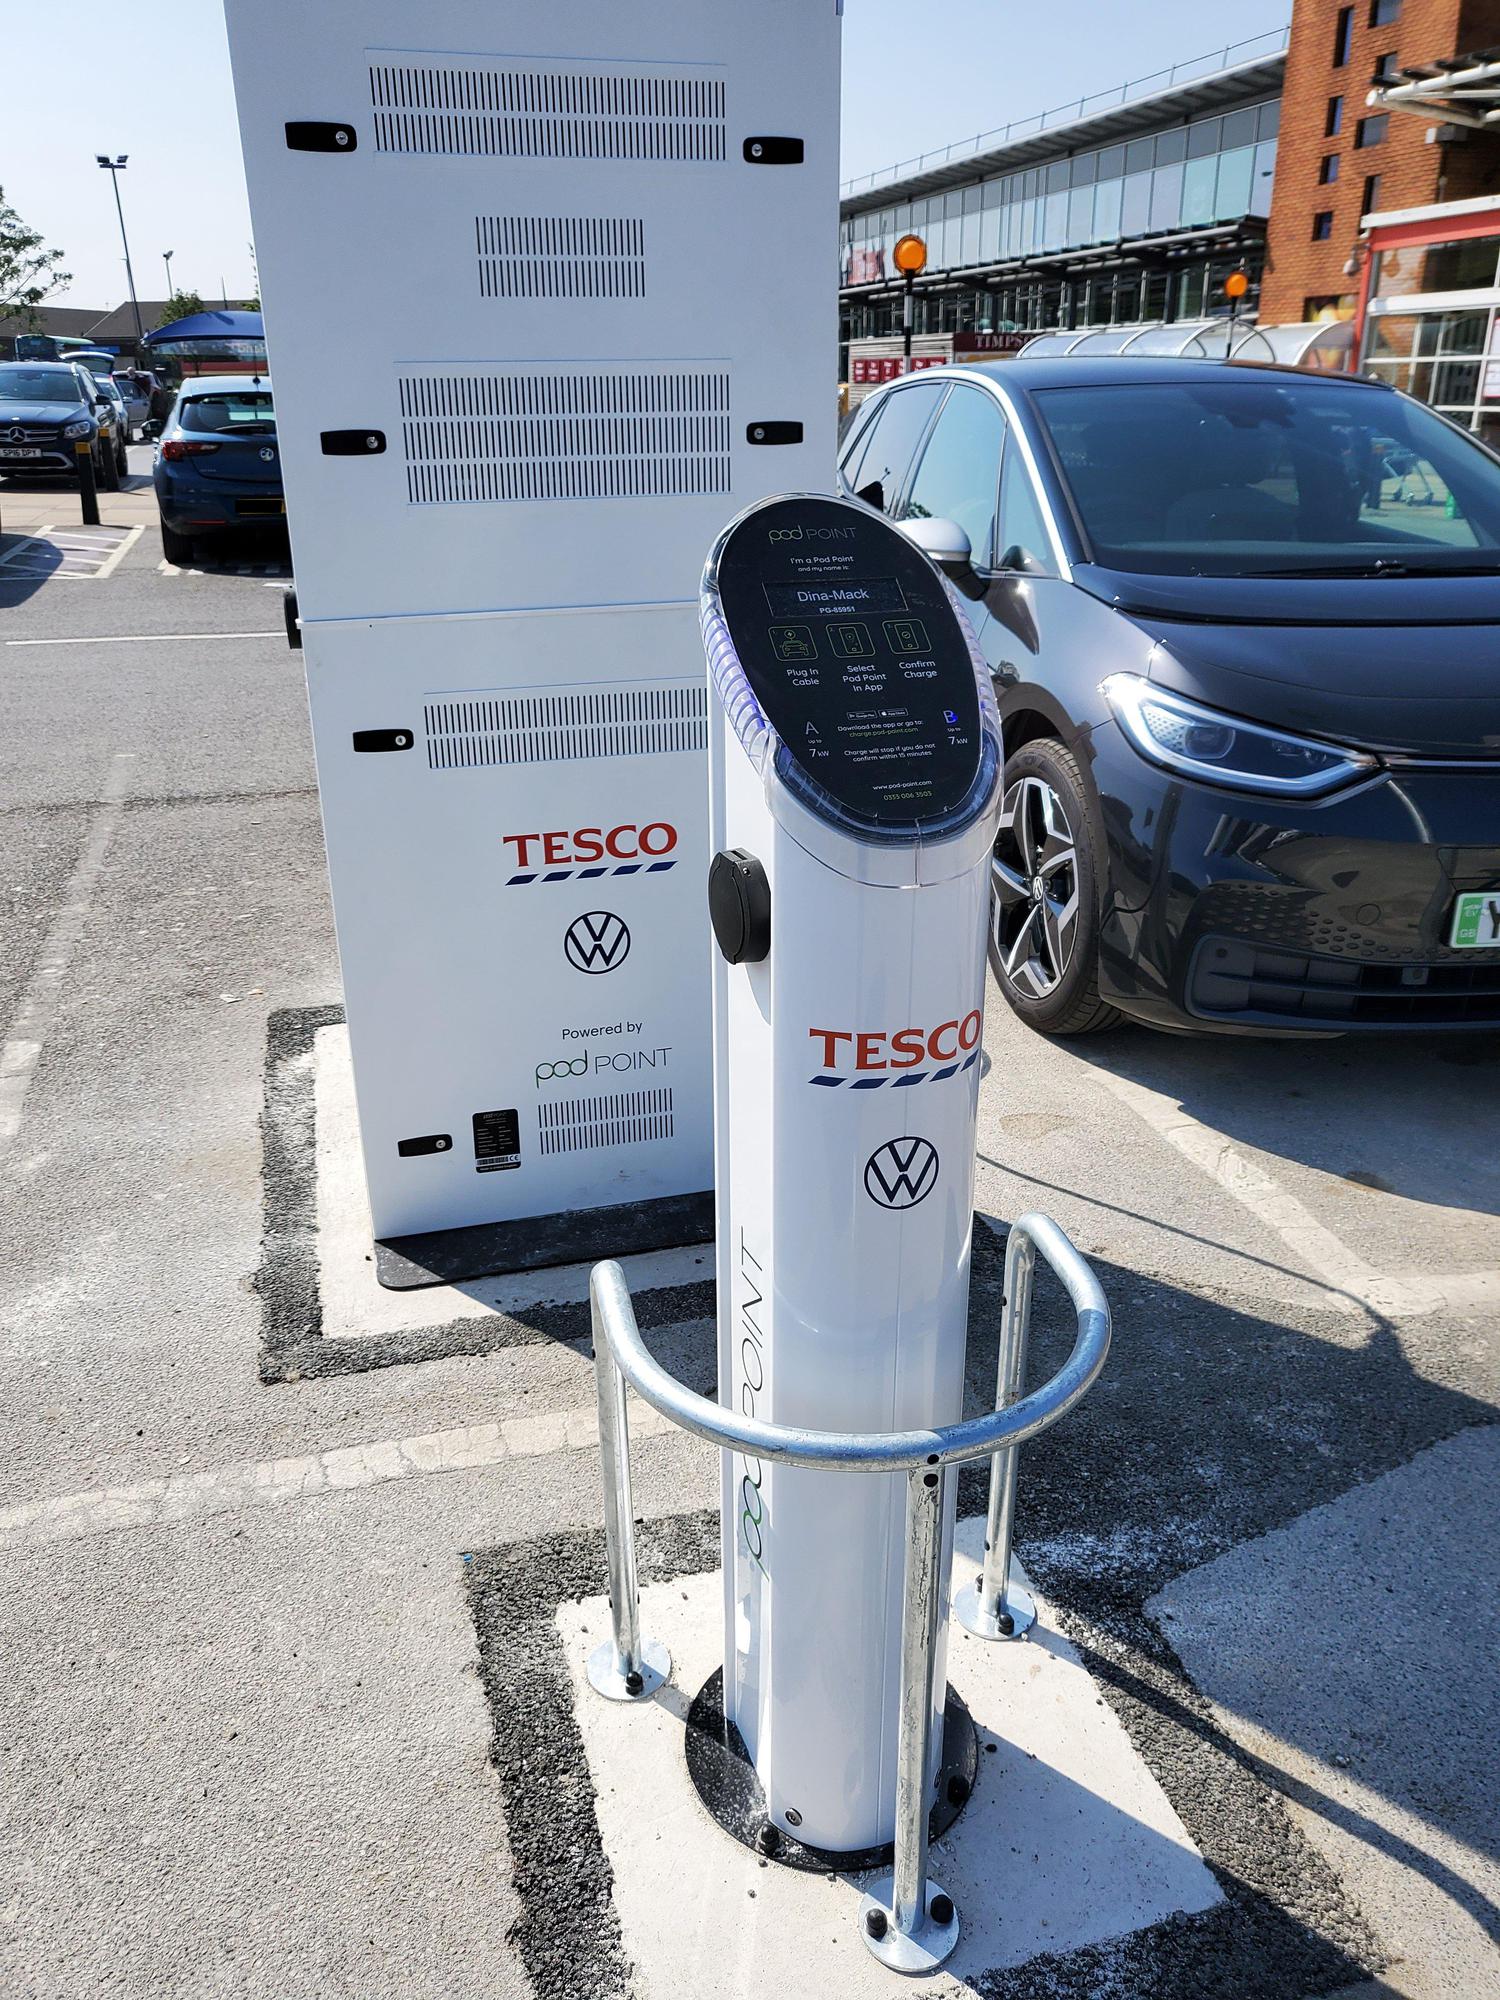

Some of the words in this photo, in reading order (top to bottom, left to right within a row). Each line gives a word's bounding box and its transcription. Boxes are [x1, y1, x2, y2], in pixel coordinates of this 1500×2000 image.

[976, 334, 1033, 349] TIMPS
[768, 525, 803, 544] pod
[806, 527, 856, 540] POINT
[813, 556, 830, 564] Pod
[832, 555, 854, 563] Point
[797, 588, 870, 602] Dina-Mack
[846, 664, 876, 673] Select
[899, 660, 936, 669] Confirm
[786, 669, 808, 678] Plug
[809, 668, 819, 676] In
[842, 674, 861, 683] Pod
[862, 673, 887, 681] Point
[904, 669, 938, 679] Charge
[792, 678, 820, 686] Cable
[853, 684, 863, 692] In
[864, 683, 883, 692] App
[943, 710, 958, 724] B
[805, 721, 819, 735] A
[837, 723, 870, 732] Download
[882, 722, 896, 730] app
[905, 720, 914, 728] go
[849, 726, 919, 738] charge.pod-point.com
[948, 736, 956, 745] 7
[956, 737, 968, 745] kW
[808, 748, 816, 758] 7
[844, 749, 868, 757] Charge
[852, 754, 878, 762] confirm
[879, 752, 898, 760] within
[872, 779, 933, 790] www.pod-point.com
[502, 822, 678, 867] TESCO
[564, 911, 631, 974] VW
[562, 1022, 623, 1040] Powered
[627, 1021, 643, 1034] by
[809, 1008, 982, 1070] TESCO
[535, 1049, 588, 1088] pod
[594, 1047, 673, 1074] POINT
[864, 1136, 939, 1210] VW
